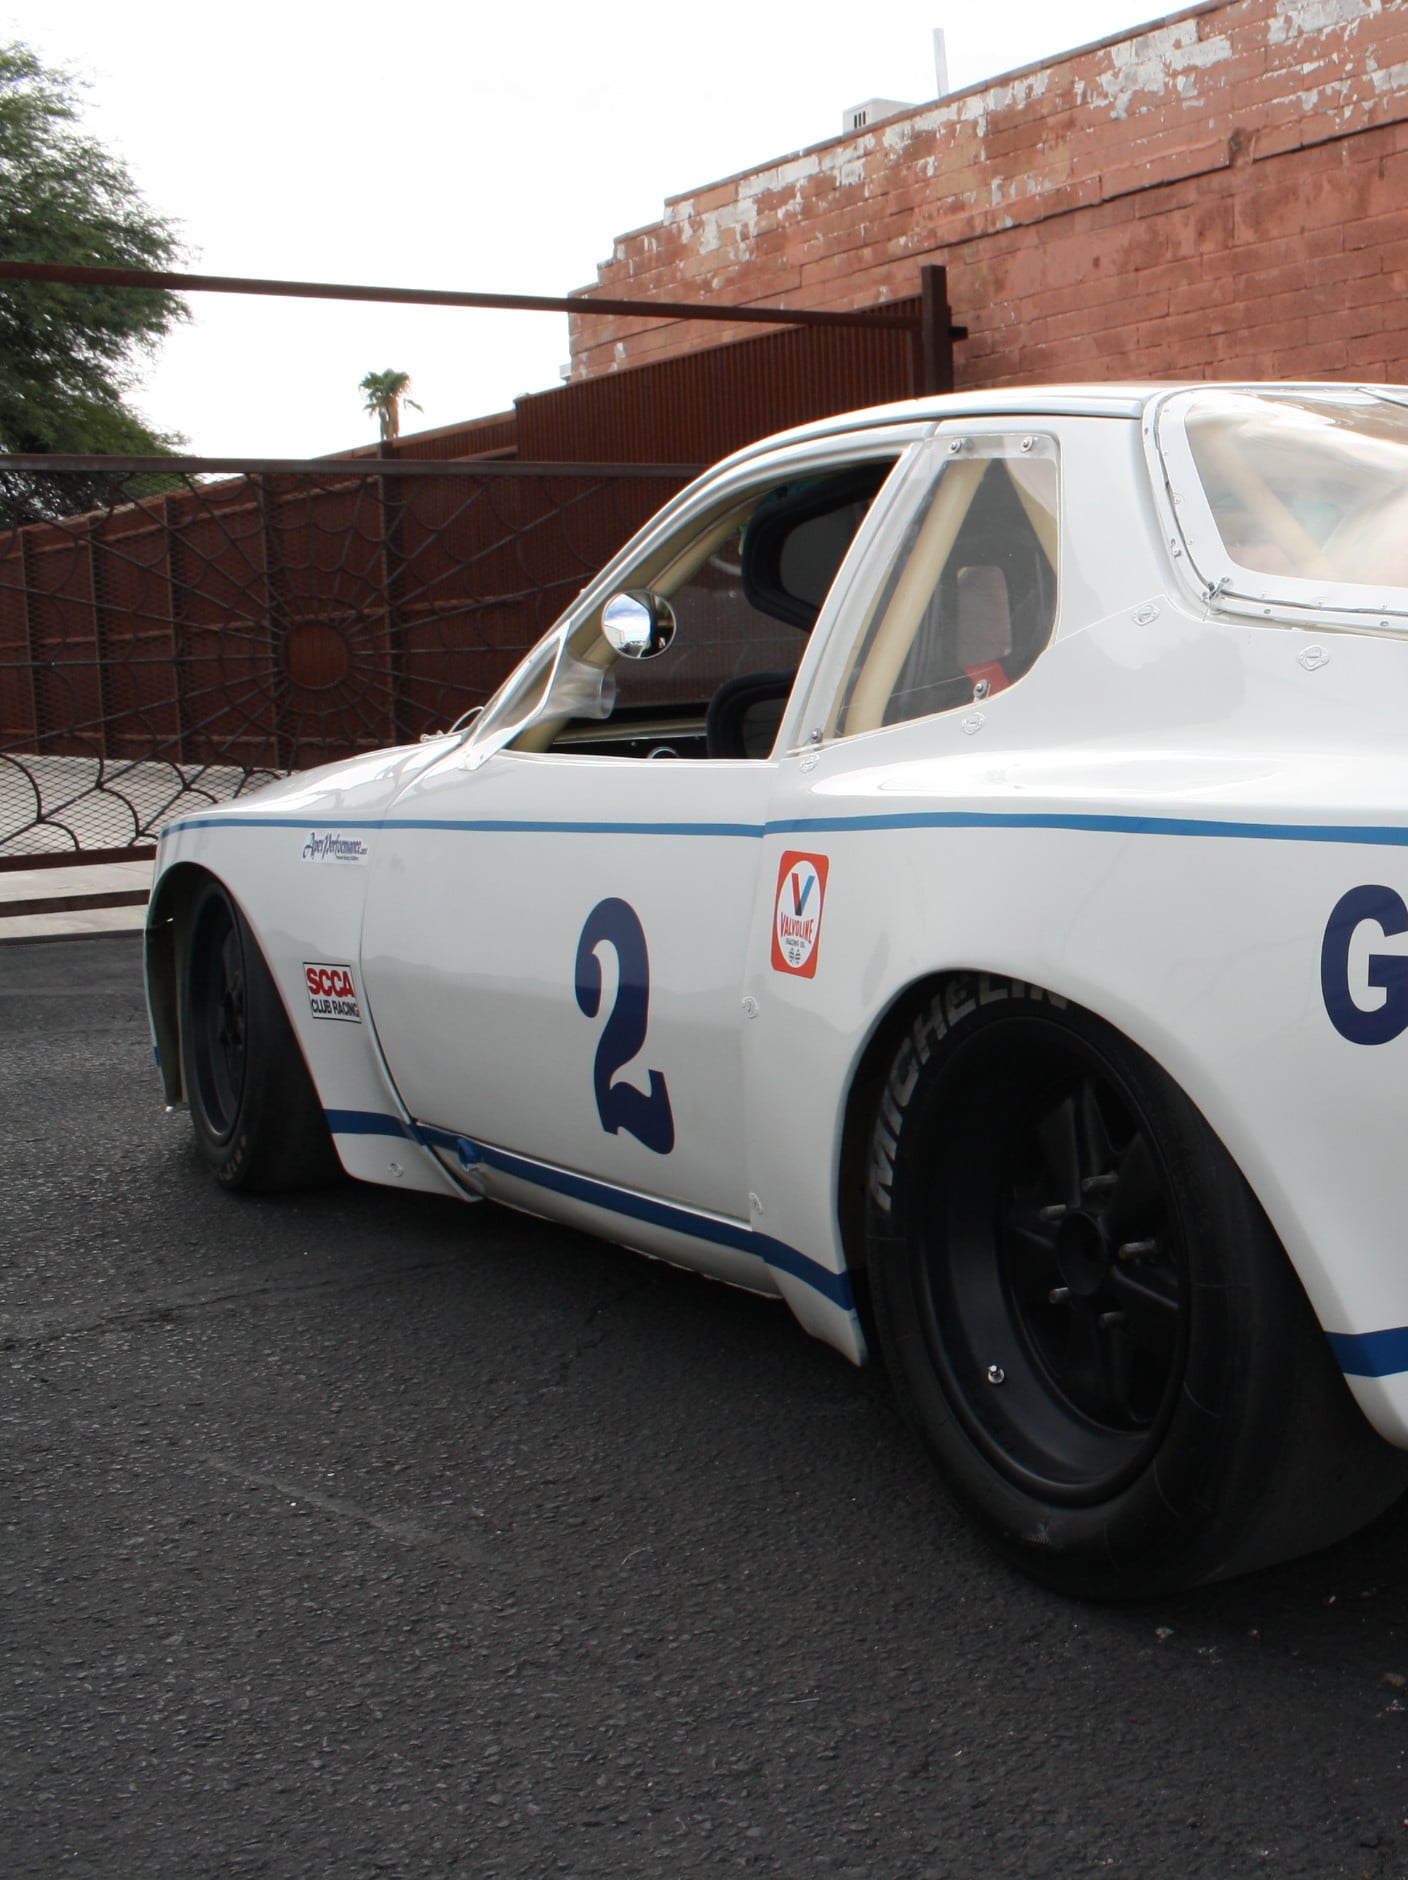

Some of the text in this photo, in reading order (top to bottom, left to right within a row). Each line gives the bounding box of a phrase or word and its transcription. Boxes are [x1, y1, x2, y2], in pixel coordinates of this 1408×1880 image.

[780, 912, 814, 944] VALVOLINE
[306, 967, 356, 998] SCCA
[311, 999, 361, 1018] CLUB RACING
[574, 897, 675, 1155] 2
